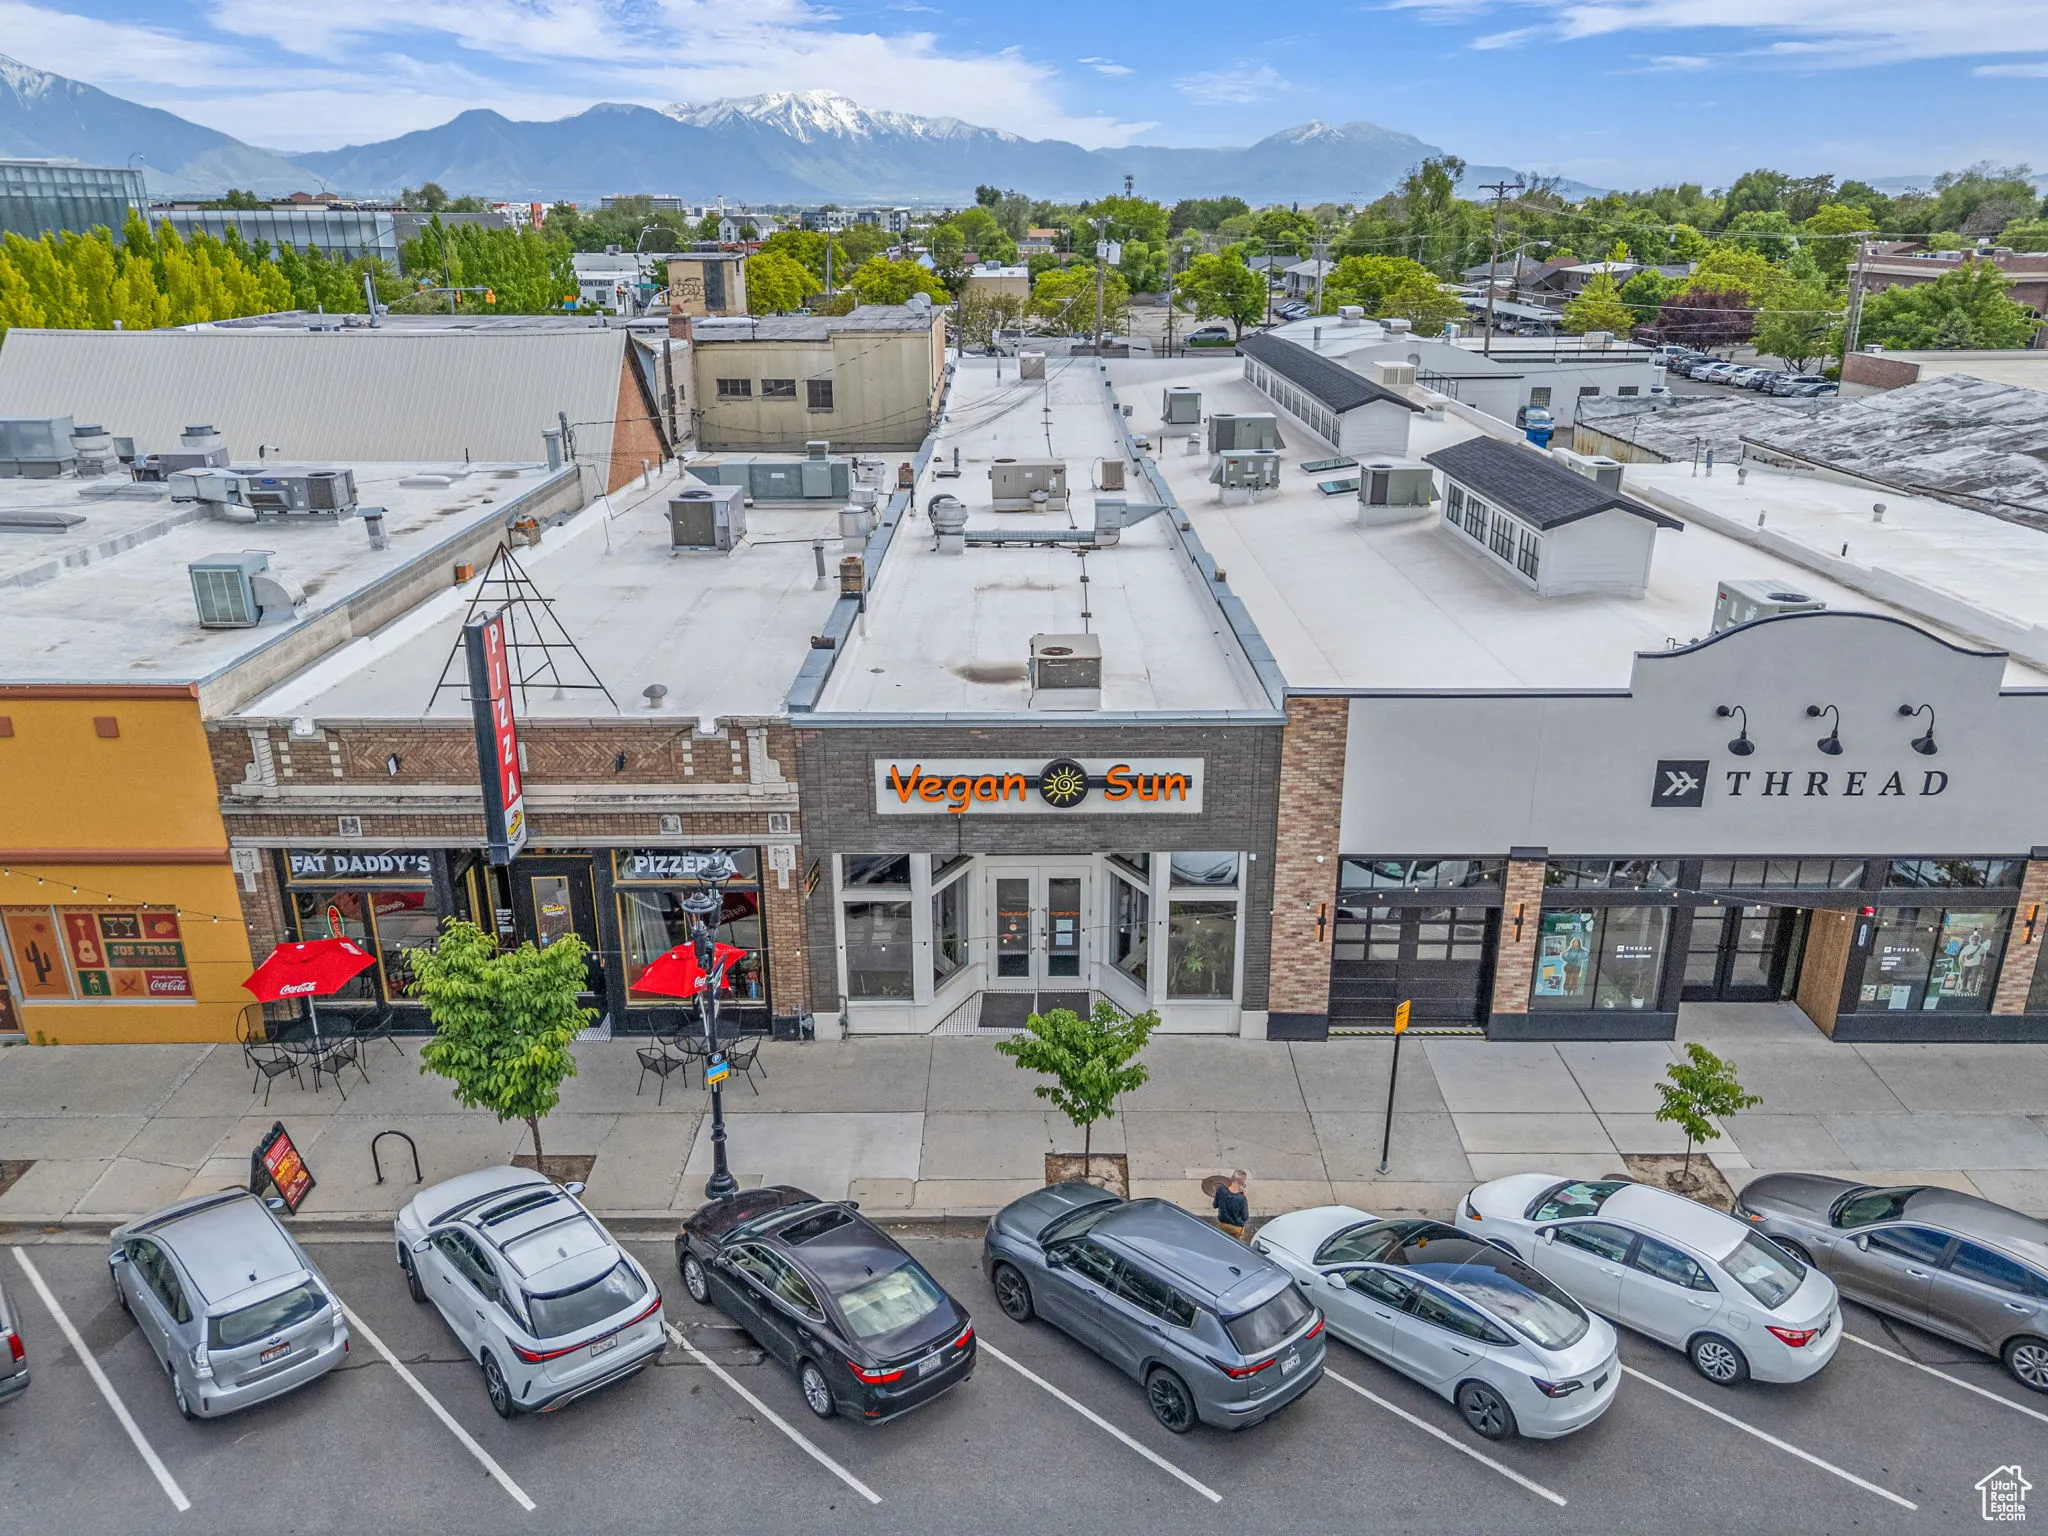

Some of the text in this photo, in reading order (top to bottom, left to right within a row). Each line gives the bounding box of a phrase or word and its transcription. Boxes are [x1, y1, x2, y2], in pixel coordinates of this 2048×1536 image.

[579, 279, 613, 287] CONTROL
[488, 623, 518, 802] PIZZA
[890, 763, 1187, 814] Vegan Sun
[1726, 770, 1950, 797] THREAD
[290, 855, 431, 873] FAT DADDY'S
[113, 945, 177, 956] JOE VERAS
